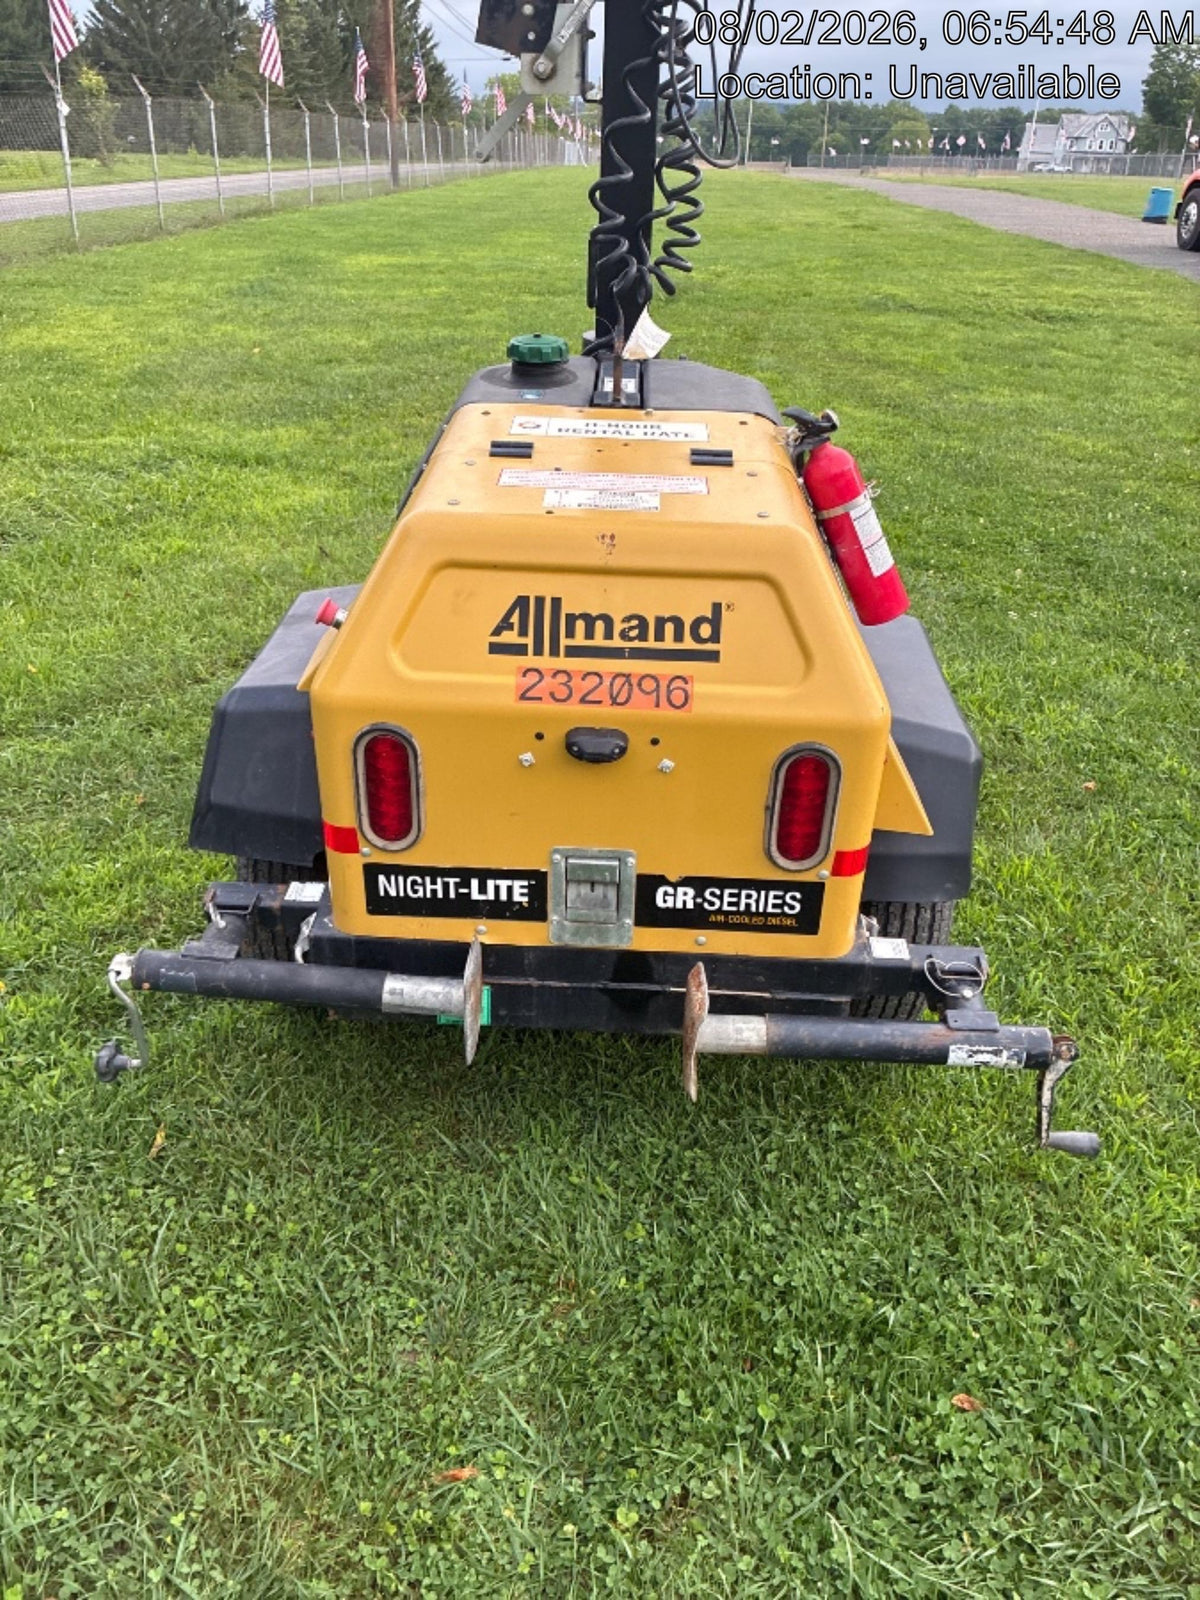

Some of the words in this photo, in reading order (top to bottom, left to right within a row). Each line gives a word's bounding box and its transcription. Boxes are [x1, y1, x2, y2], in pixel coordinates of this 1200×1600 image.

[489, 595, 723, 658] Allmand
[518, 667, 690, 710] 232096
[655, 885, 802, 915] GR-SERIES
[766, 916, 798, 927] DIESEL
